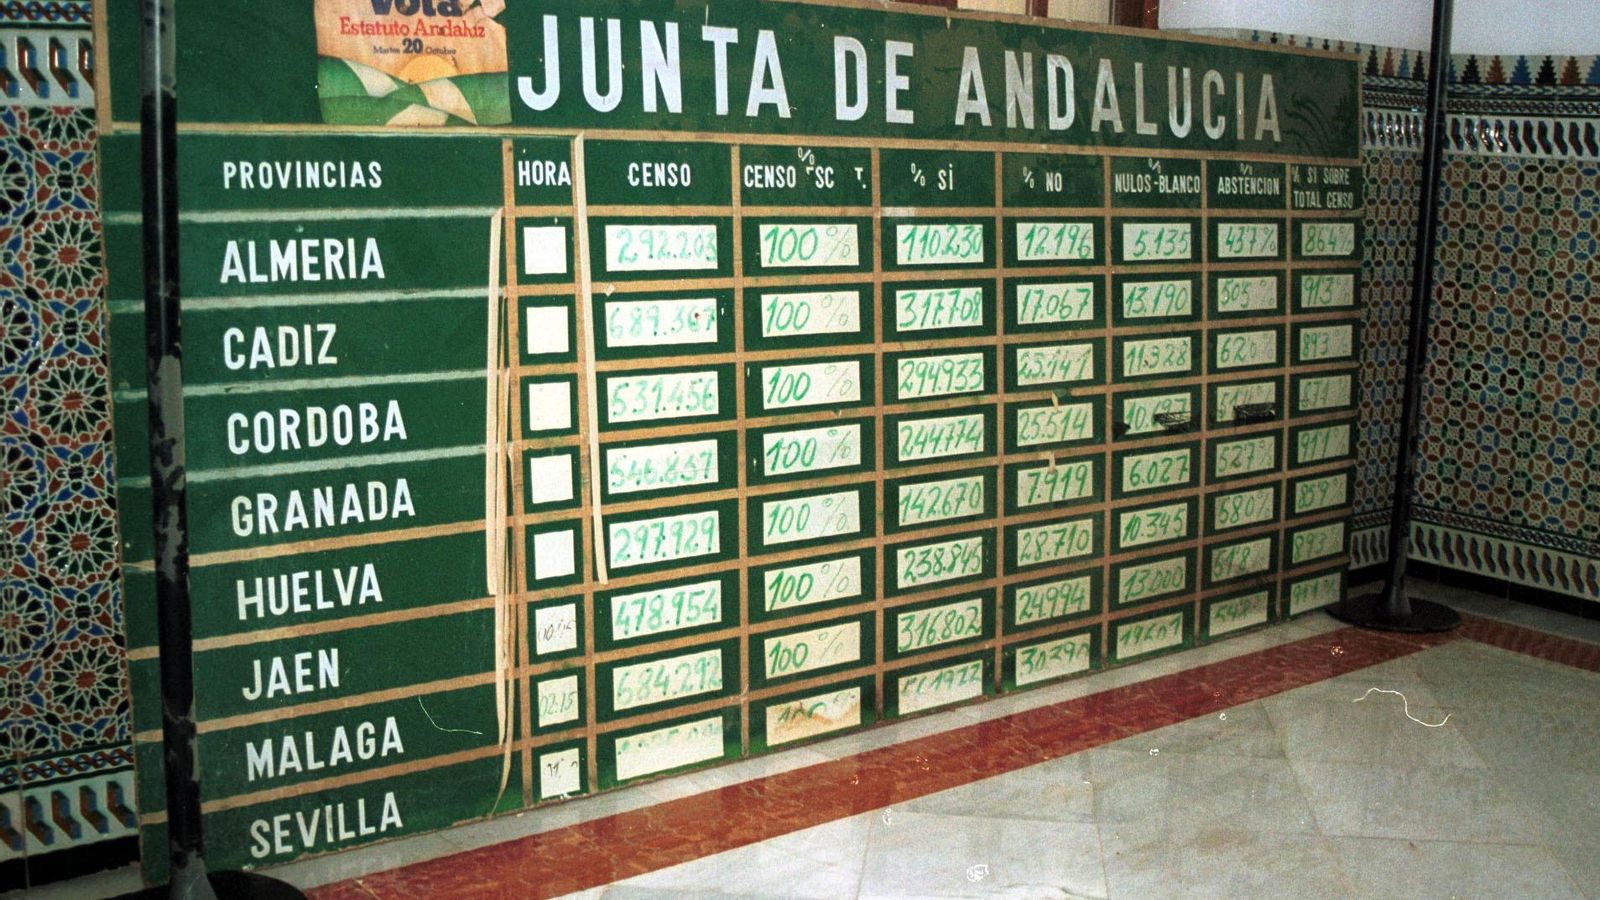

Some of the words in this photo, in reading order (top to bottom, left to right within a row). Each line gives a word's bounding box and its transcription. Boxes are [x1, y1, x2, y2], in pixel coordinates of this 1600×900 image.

[339, 16, 410, 36] Estatuto
[402, 38, 424, 54] 20
[517, 14, 792, 119] JUNTA
[833, 36, 915, 125] DE
[954, 46, 1283, 142] ANDALUCIA
[223, 161, 383, 189] PROVINCIAS
[518, 160, 572, 186] HORA
[628, 162, 692, 187] CENSO
[743, 165, 797, 188] CENSO
[910, 162, 926, 187] %
[1022, 166, 1035, 189] %
[1045, 172, 1063, 192] NO
[1217, 177, 1280, 195] ABSTENCION
[1323, 167, 1351, 185] SOBRE
[1293, 191, 1323, 208] TOTAL
[1326, 191, 1354, 208] CENSO
[220, 237, 385, 283] ALMERIA
[223, 323, 338, 370] CADIZ
[227, 399, 408, 455] CORDOBA
[230, 478, 416, 537] GRANADA
[235, 563, 384, 620] HUELVA
[242, 648, 340, 701] JAEN
[245, 716, 404, 782] MALAGA
[249, 791, 404, 859] SEVILLA
